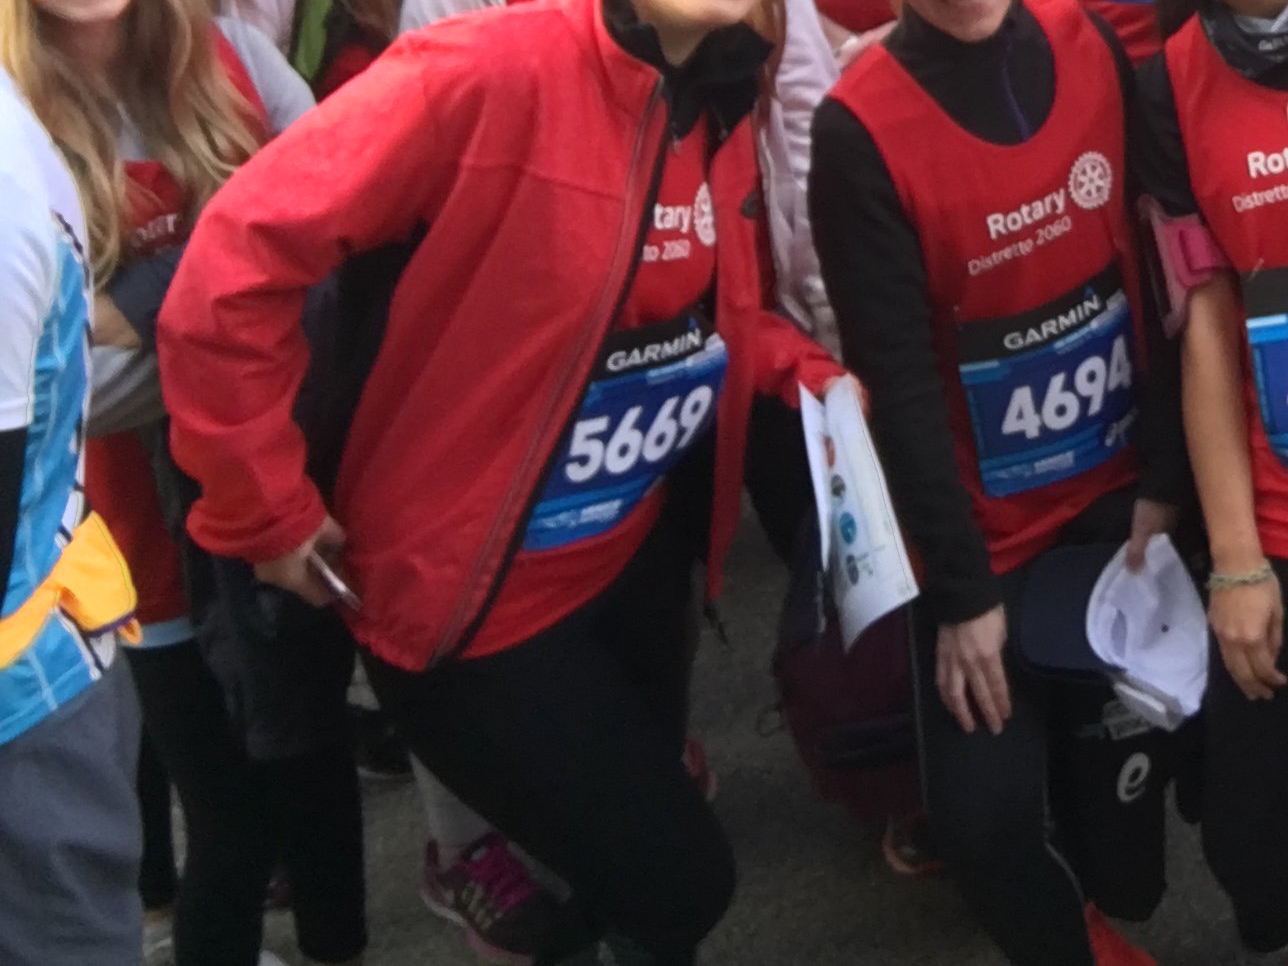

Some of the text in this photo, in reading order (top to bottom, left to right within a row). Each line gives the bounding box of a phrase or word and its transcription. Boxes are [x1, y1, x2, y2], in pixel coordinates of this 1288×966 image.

[654, 203, 692, 234] tary
[986, 188, 1067, 240] Rotary
[967, 216, 1072, 276] Distretto 2060
[606, 329, 702, 371] GARMIN
[1003, 295, 1101, 350] GARMIN
[1001, 334, 1132, 439] 4694
[565, 385, 713, 482] 5669
